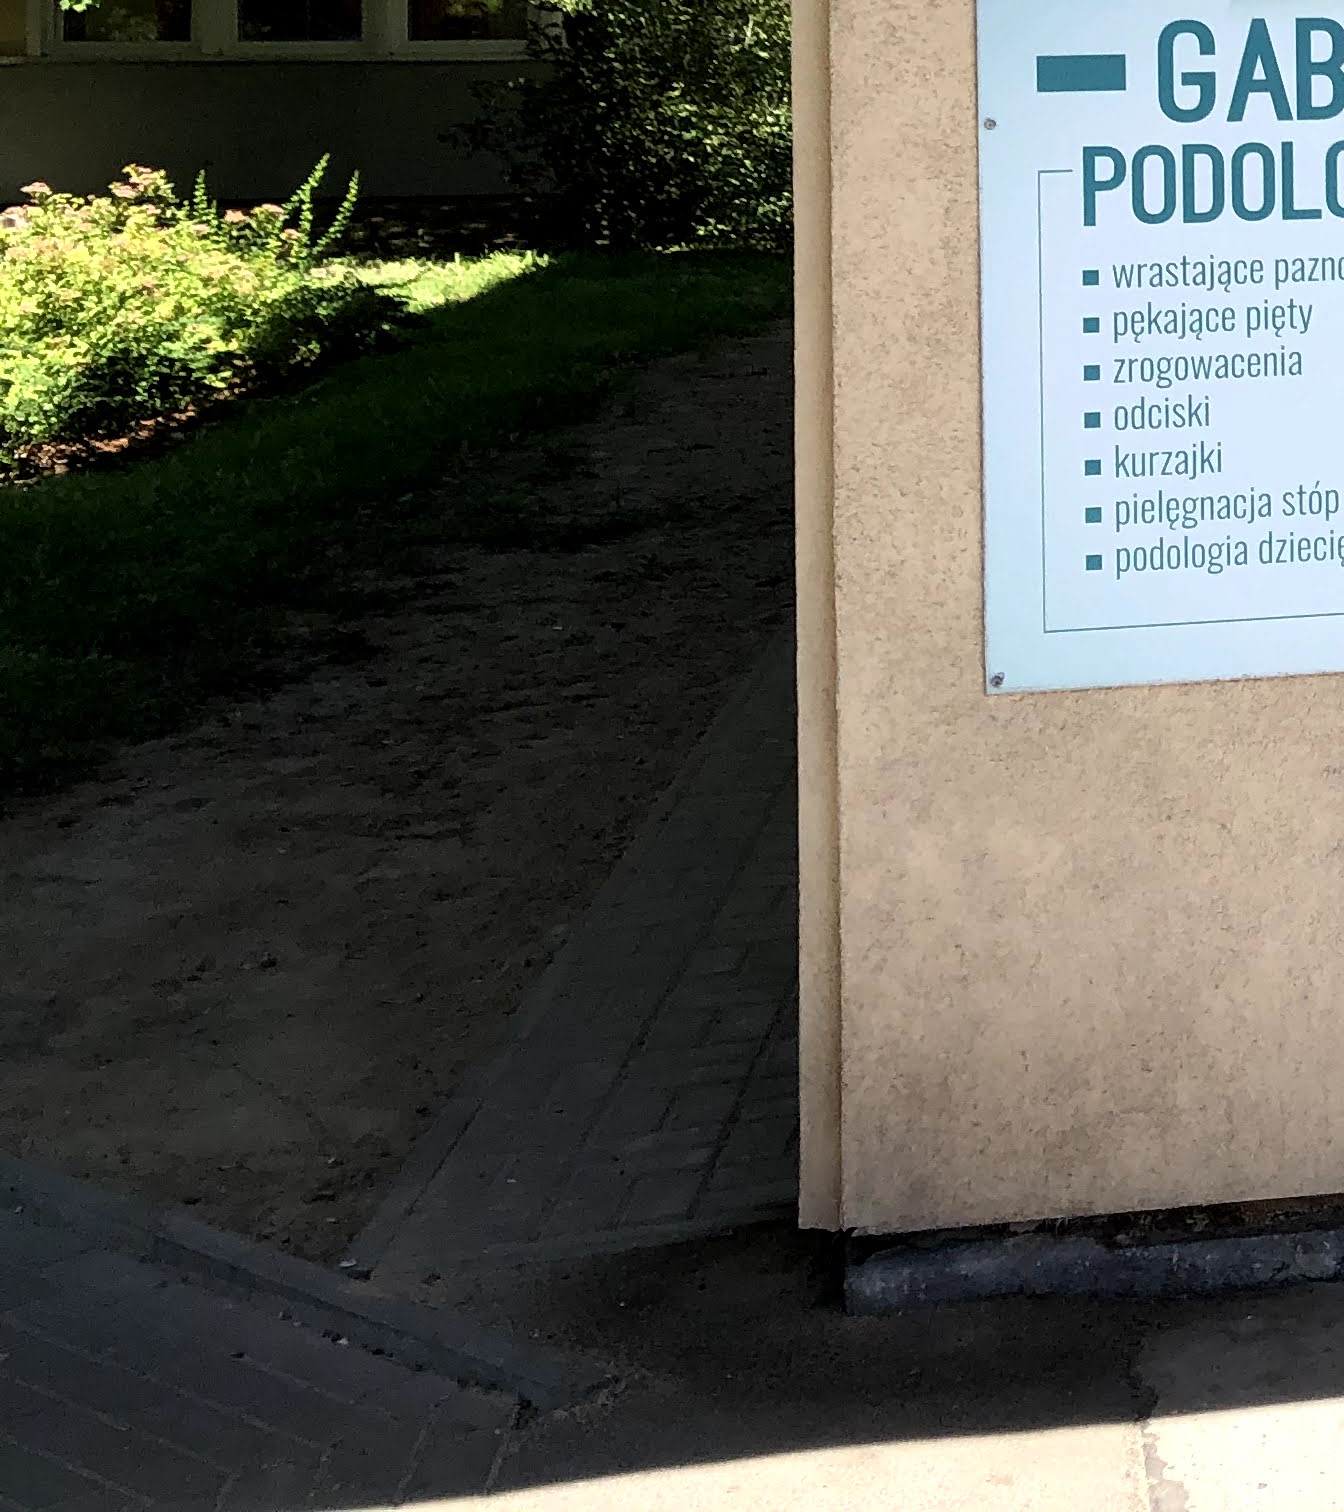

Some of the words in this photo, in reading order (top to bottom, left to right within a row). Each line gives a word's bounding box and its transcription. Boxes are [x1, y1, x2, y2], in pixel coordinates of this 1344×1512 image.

[1113, 255, 1264, 293] wrastające
[1113, 302, 1235, 343] pękające
[1247, 298, 1313, 338] pięty
[1113, 345, 1302, 389] zrogowacenia
[1114, 394, 1210, 431] odciski
[1115, 440, 1222, 480] kurzajki
[1116, 487, 1272, 533] pielęgnacja
[1282, 480, 1339, 522] stóp
[1116, 535, 1248, 580] podologia
